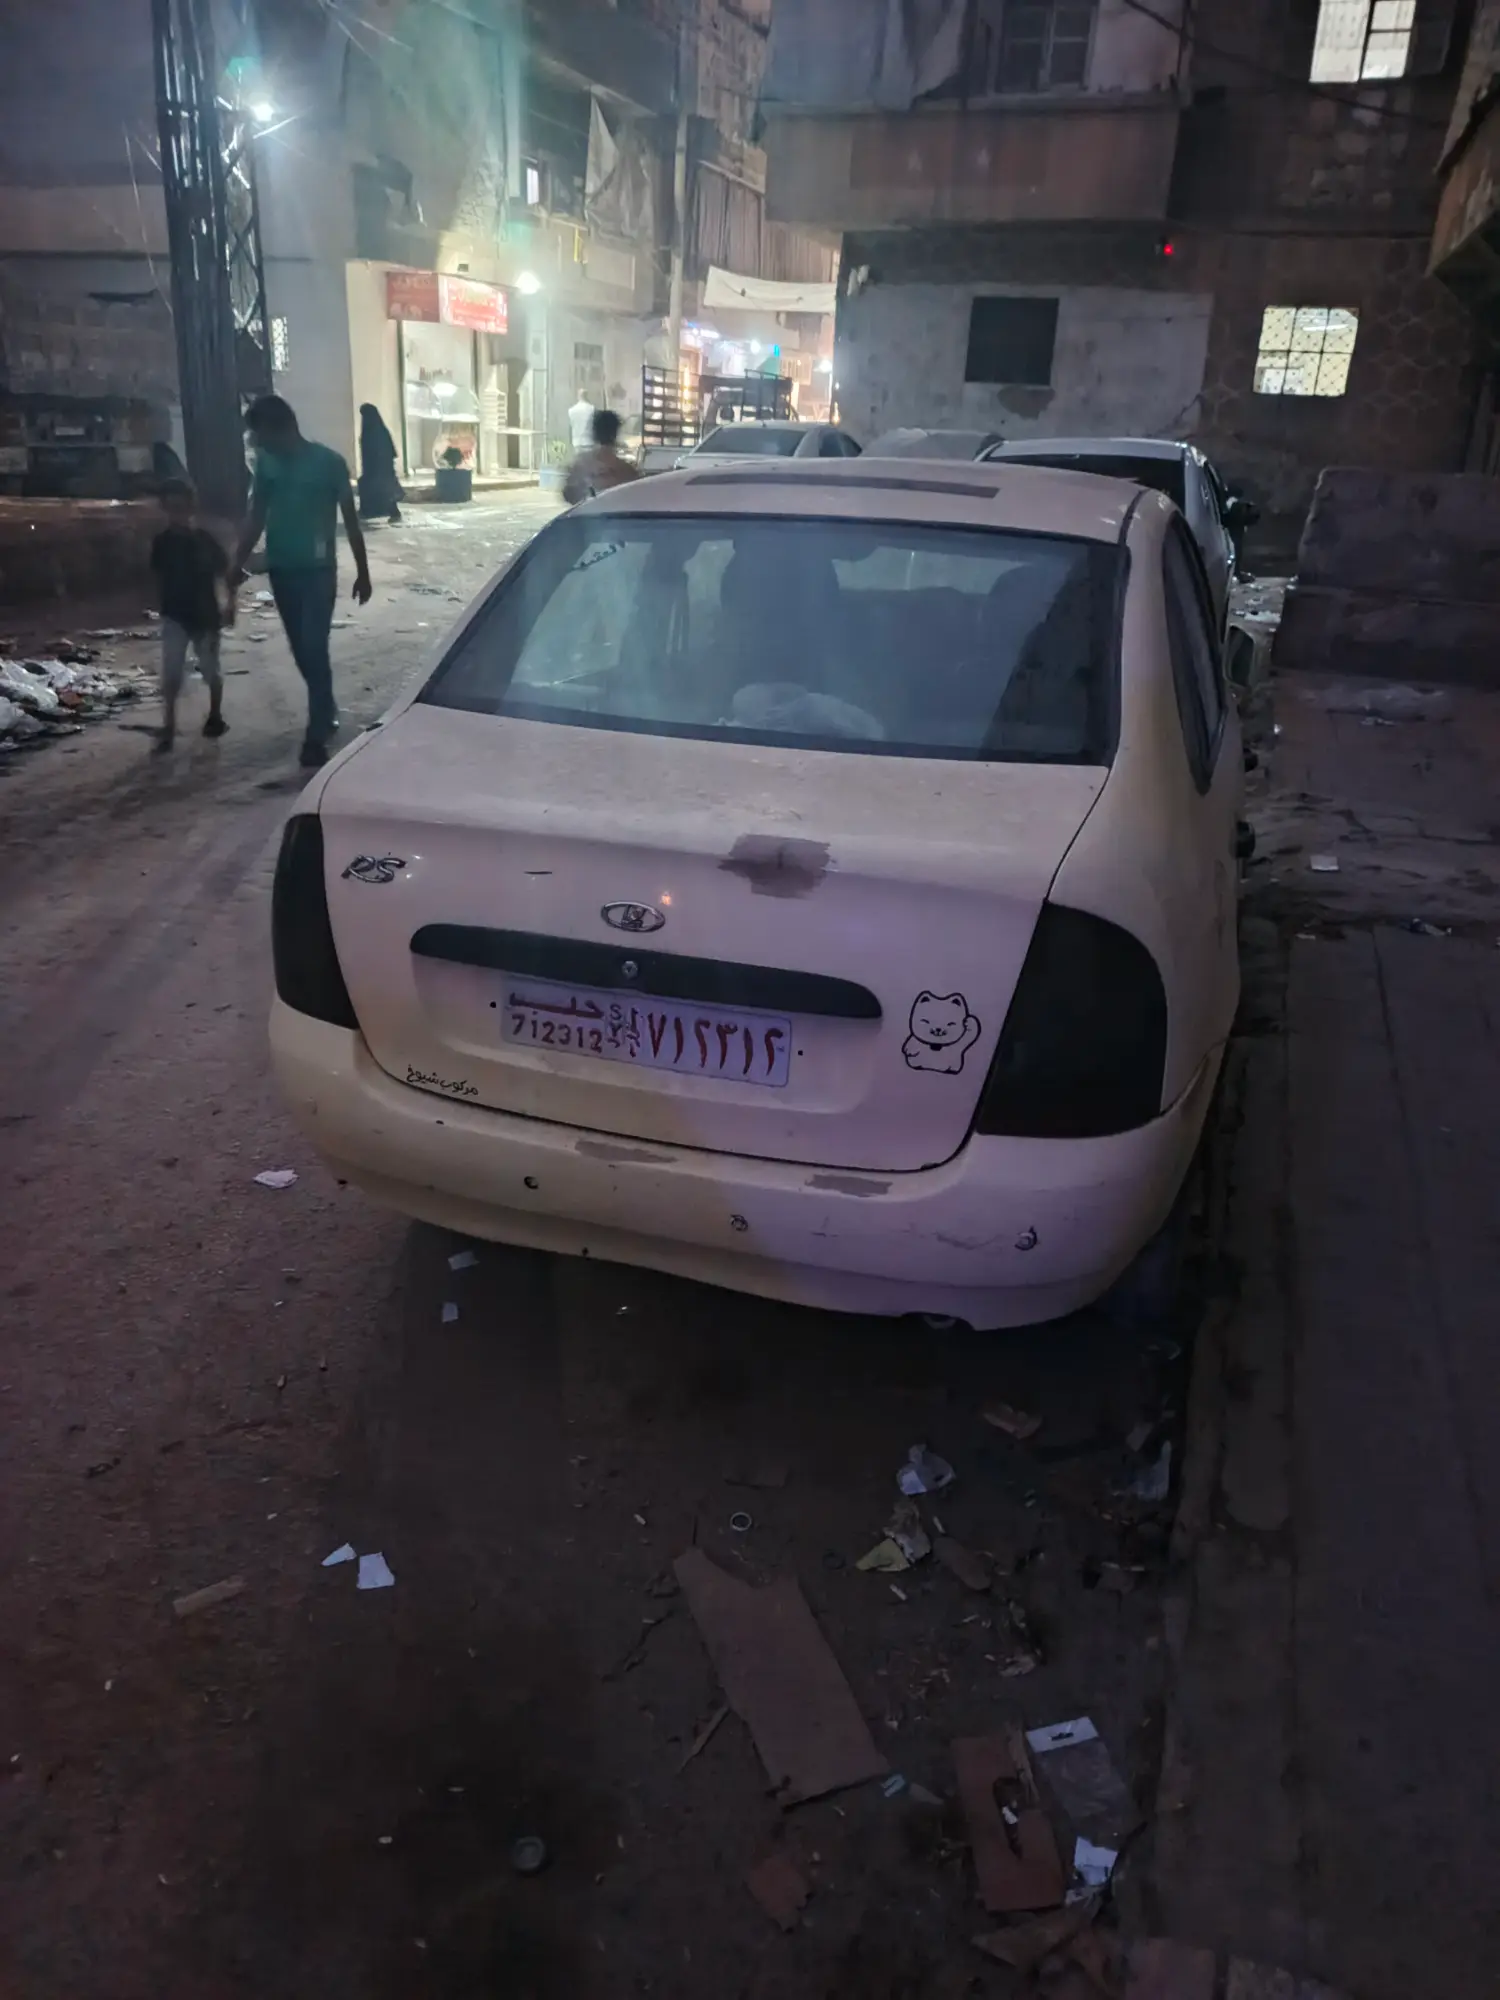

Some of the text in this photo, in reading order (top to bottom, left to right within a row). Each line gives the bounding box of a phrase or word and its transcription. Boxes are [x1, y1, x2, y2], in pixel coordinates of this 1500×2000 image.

[511, 1013, 603, 1054] 712312
[647, 1011, 784, 1077] ٧١٢٣١٢
[406, 1063, 439, 1085] شيوخ
